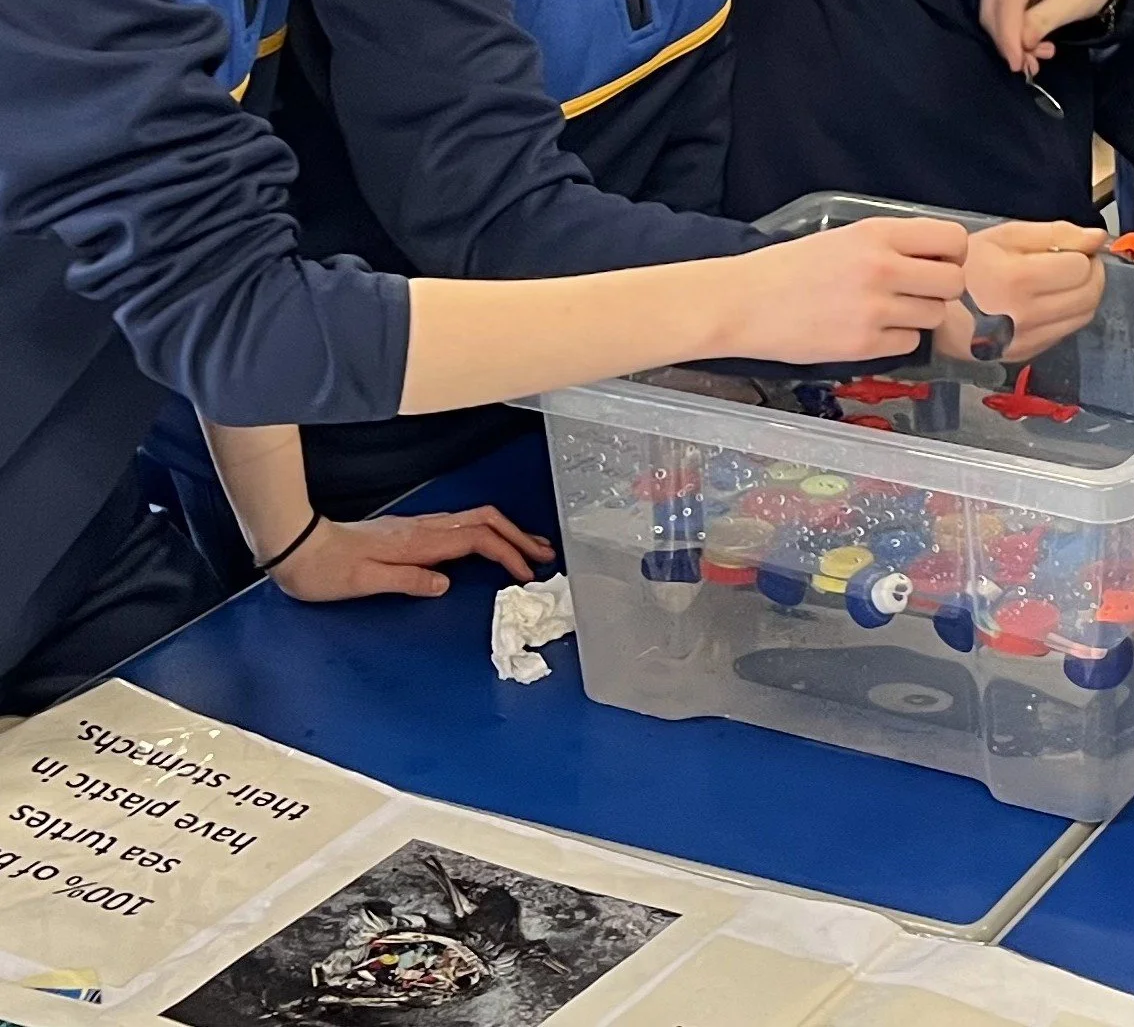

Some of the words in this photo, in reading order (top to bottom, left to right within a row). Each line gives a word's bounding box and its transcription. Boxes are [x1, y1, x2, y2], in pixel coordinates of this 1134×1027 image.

[32, 756, 68, 783] in
[77, 719, 231, 787] stomachs.
[66, 772, 180, 818] plastic
[227, 784, 310, 821] their
[9, 803, 118, 856] turtles
[174, 812, 257, 855] have
[8, 860, 60, 880] of
[119, 845, 181, 874] sea
[52, 875, 155, 916] 100%
